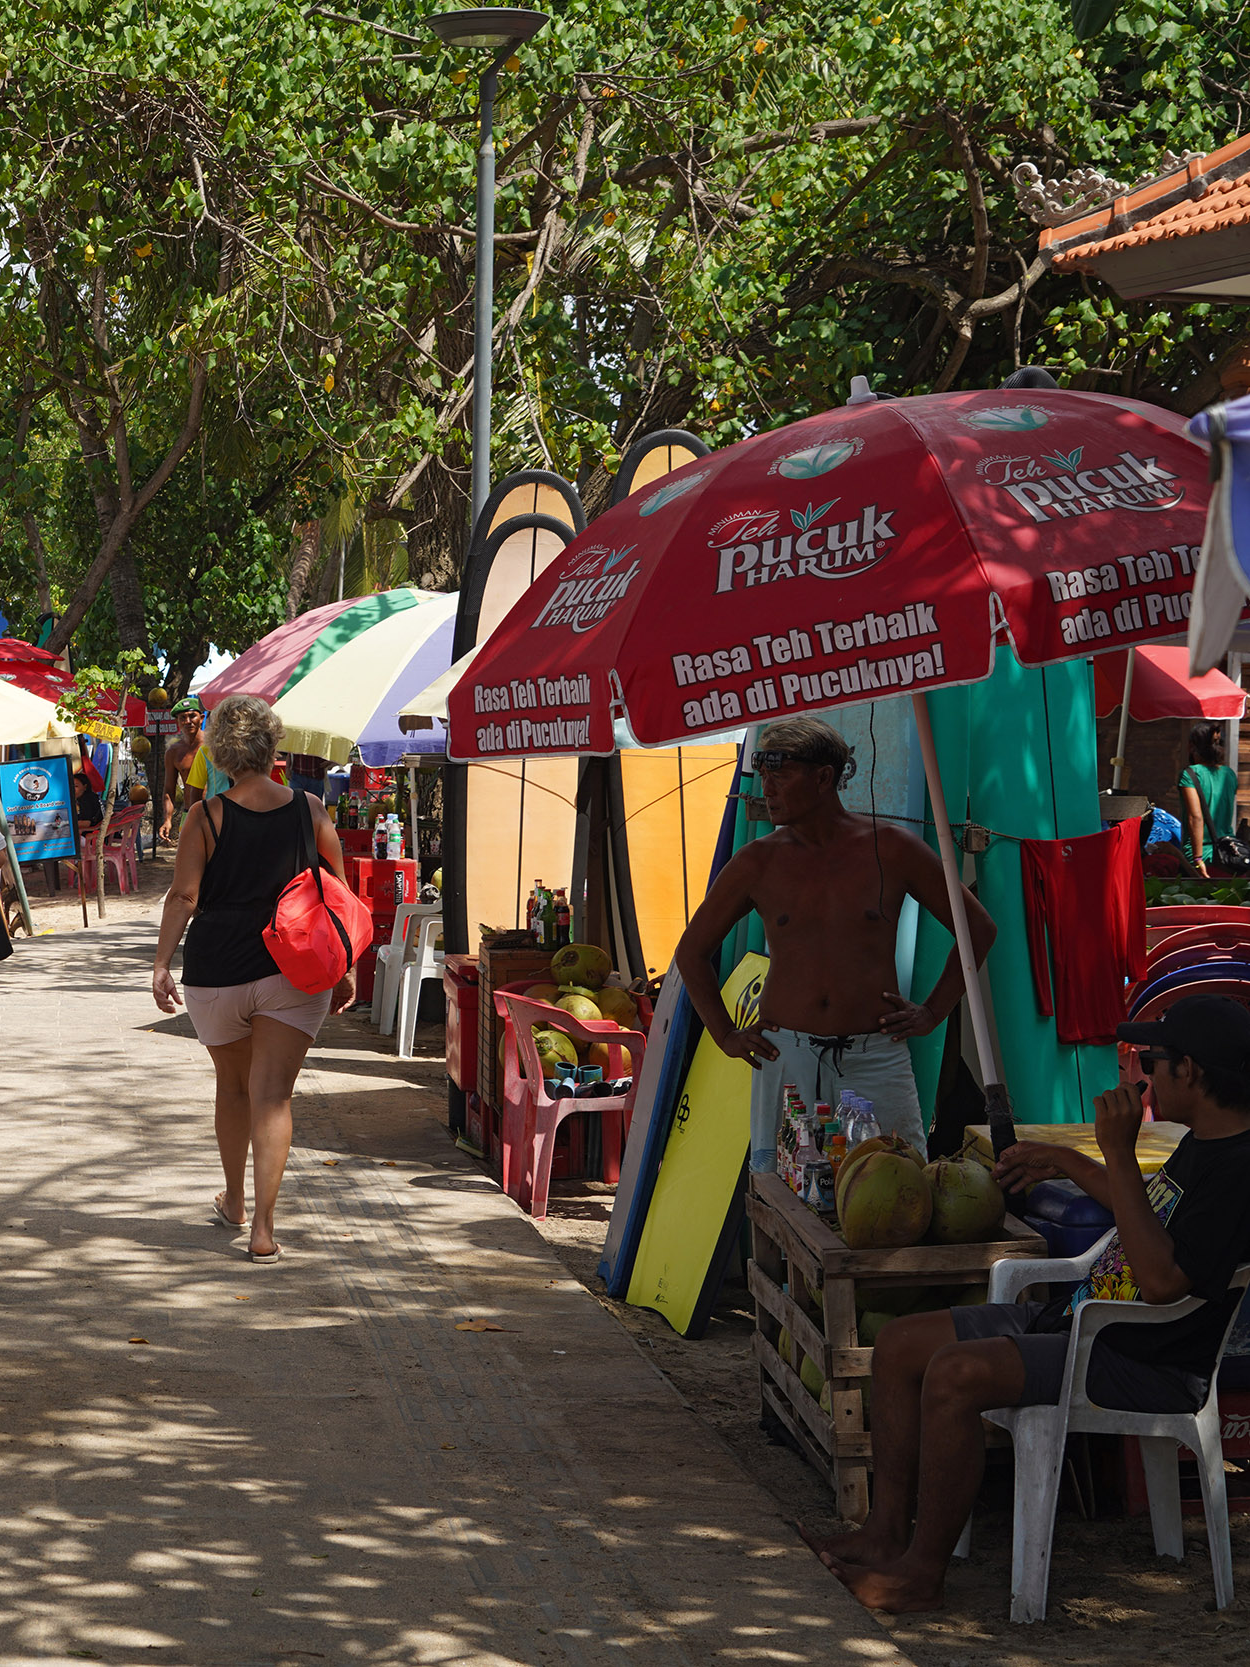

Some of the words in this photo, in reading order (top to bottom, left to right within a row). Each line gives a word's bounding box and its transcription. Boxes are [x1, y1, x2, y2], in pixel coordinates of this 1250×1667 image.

[984, 455, 1047, 486] Teh
[1003, 452, 1180, 523] pucuk
[1051, 482, 1180, 518] HARUM
[707, 509, 762, 536] MINUMAN
[707, 510, 781, 548] Teh
[559, 548, 610, 580] Teh
[715, 503, 899, 595] pucuk
[746, 545, 885, 587] HARUM
[530, 558, 642, 628] pucuk
[1047, 564, 1119, 602] Rasa
[1117, 551, 1173, 587] Teh
[545, 600, 610, 632] HARUM
[1061, 607, 1111, 644] ada
[1113, 597, 1143, 632] di
[673, 646, 751, 686] Rasa
[753, 629, 812, 667] Teh
[814, 602, 938, 654] Terbaik
[474, 685, 510, 713] Rasa
[510, 680, 537, 709] Teh
[538, 673, 591, 706] Terbaik
[683, 690, 742, 728] ada
[745, 678, 778, 713] di
[781, 643, 946, 706] Pucuknya!
[93, 722, 116, 738] BAR
[476, 721, 504, 752] ada
[506, 718, 522, 749] di
[522, 715, 591, 748] Pucuknya!
